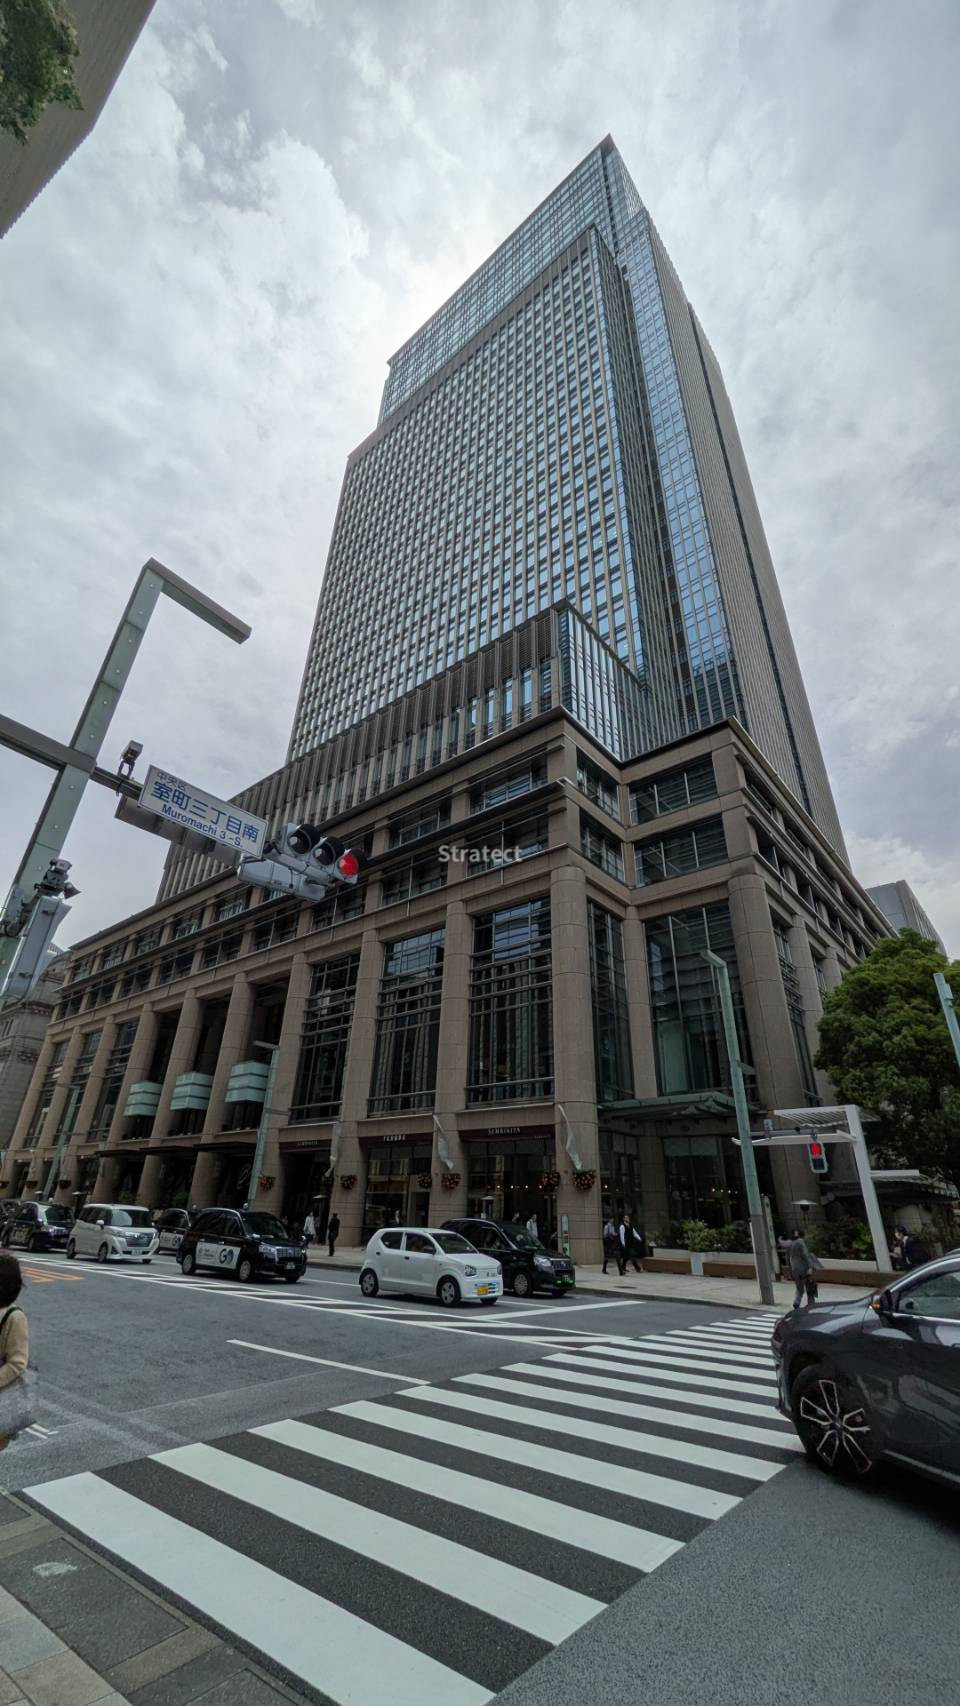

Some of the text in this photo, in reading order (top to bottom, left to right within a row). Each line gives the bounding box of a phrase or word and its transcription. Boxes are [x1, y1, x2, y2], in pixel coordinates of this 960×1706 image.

[151, 781, 260, 843] 室町三丁目南
[162, 804, 218, 836] Muromachi
